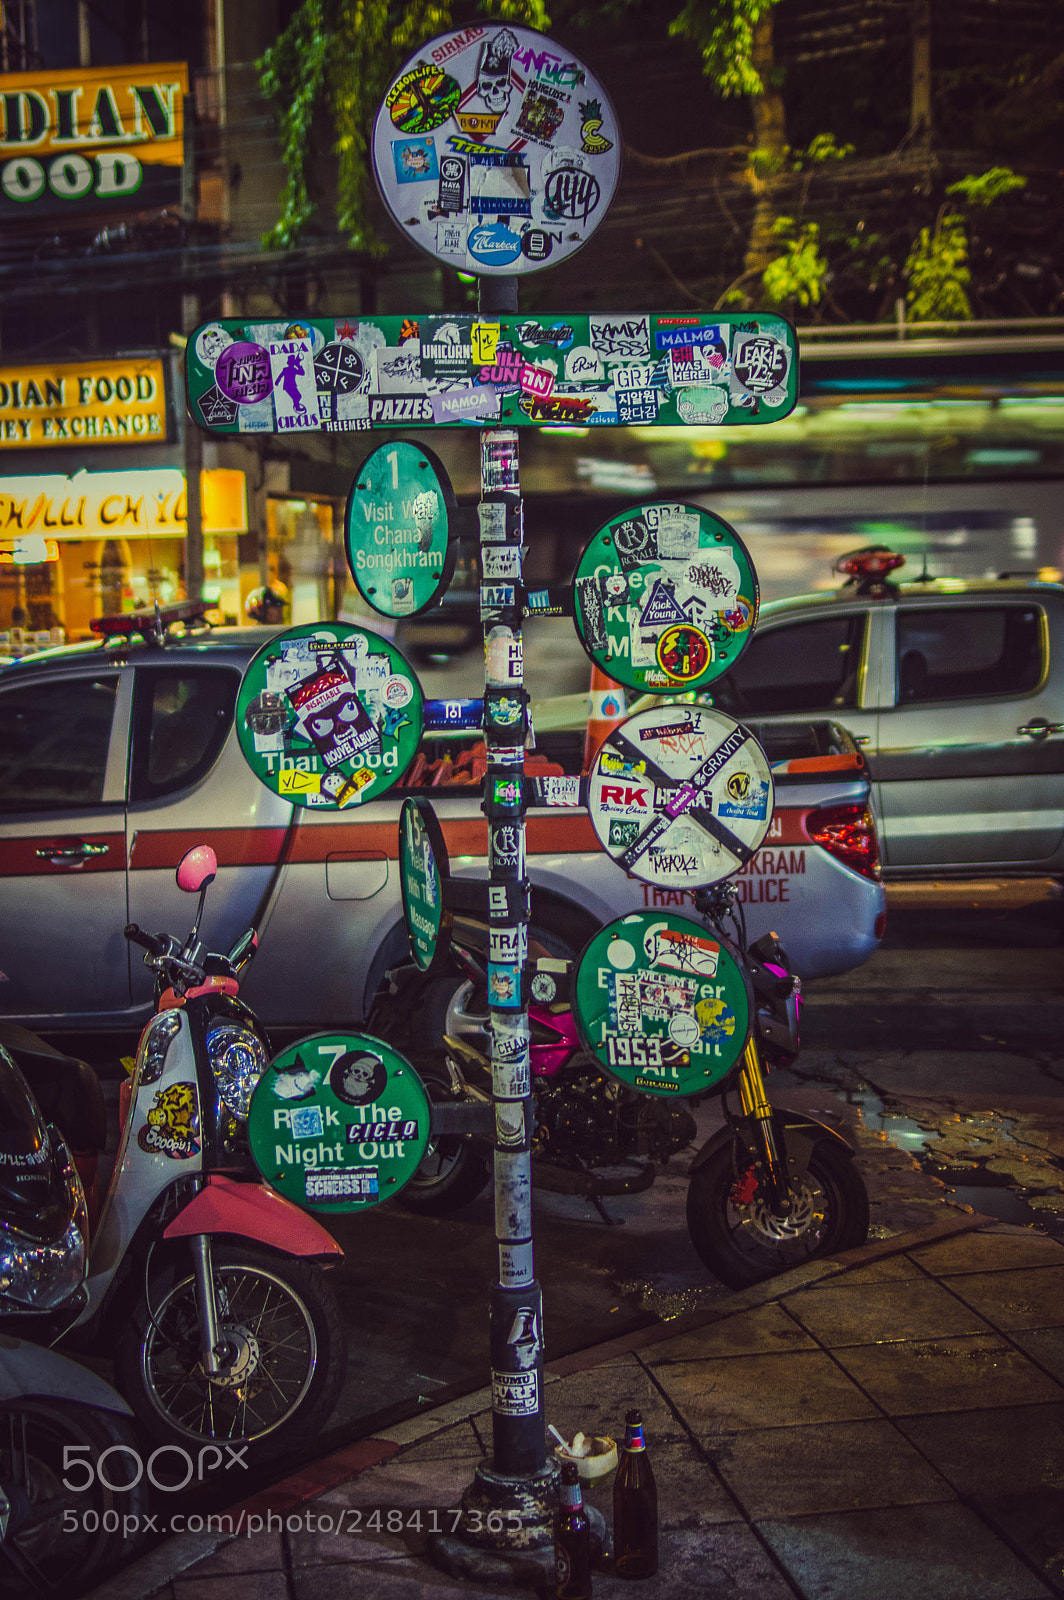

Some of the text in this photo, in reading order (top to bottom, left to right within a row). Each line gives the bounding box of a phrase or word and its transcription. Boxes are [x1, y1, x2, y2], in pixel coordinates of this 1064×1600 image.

[270, 342, 309, 355] DADA
[480, 366, 519, 382] SUN
[673, 361, 701, 372] WAS
[674, 370, 710, 381] HERE!
[78, 376, 156, 406] FOOD
[371, 398, 433, 420] PAZZES
[441, 393, 488, 412] NAMOA
[42, 414, 161, 439] EXCHANGE
[278, 413, 319, 429] CIRCUS
[326, 419, 372, 432] HELEMESE
[386, 451, 398, 490] 1
[363, 502, 394, 522] Visit
[374, 525, 422, 545] Chana
[356, 549, 443, 573] Songkhram
[621, 548, 655, 567] ROYALE
[652, 600, 672, 609] Kick
[649, 610, 677, 625] Young
[304, 687, 342, 712] INSATIABLE
[323, 726, 379, 765] NOUVEL ALBUM
[350, 746, 399, 769] ood
[601, 785, 648, 808] RK
[410, 904, 436, 941] Massage
[607, 1037, 663, 1067] 1953
[318, 1044, 346, 1085] 7
[273, 1103, 402, 1129] Rk The
[348, 1120, 417, 1140] CICLO
[275, 1140, 405, 1167] Night Out
